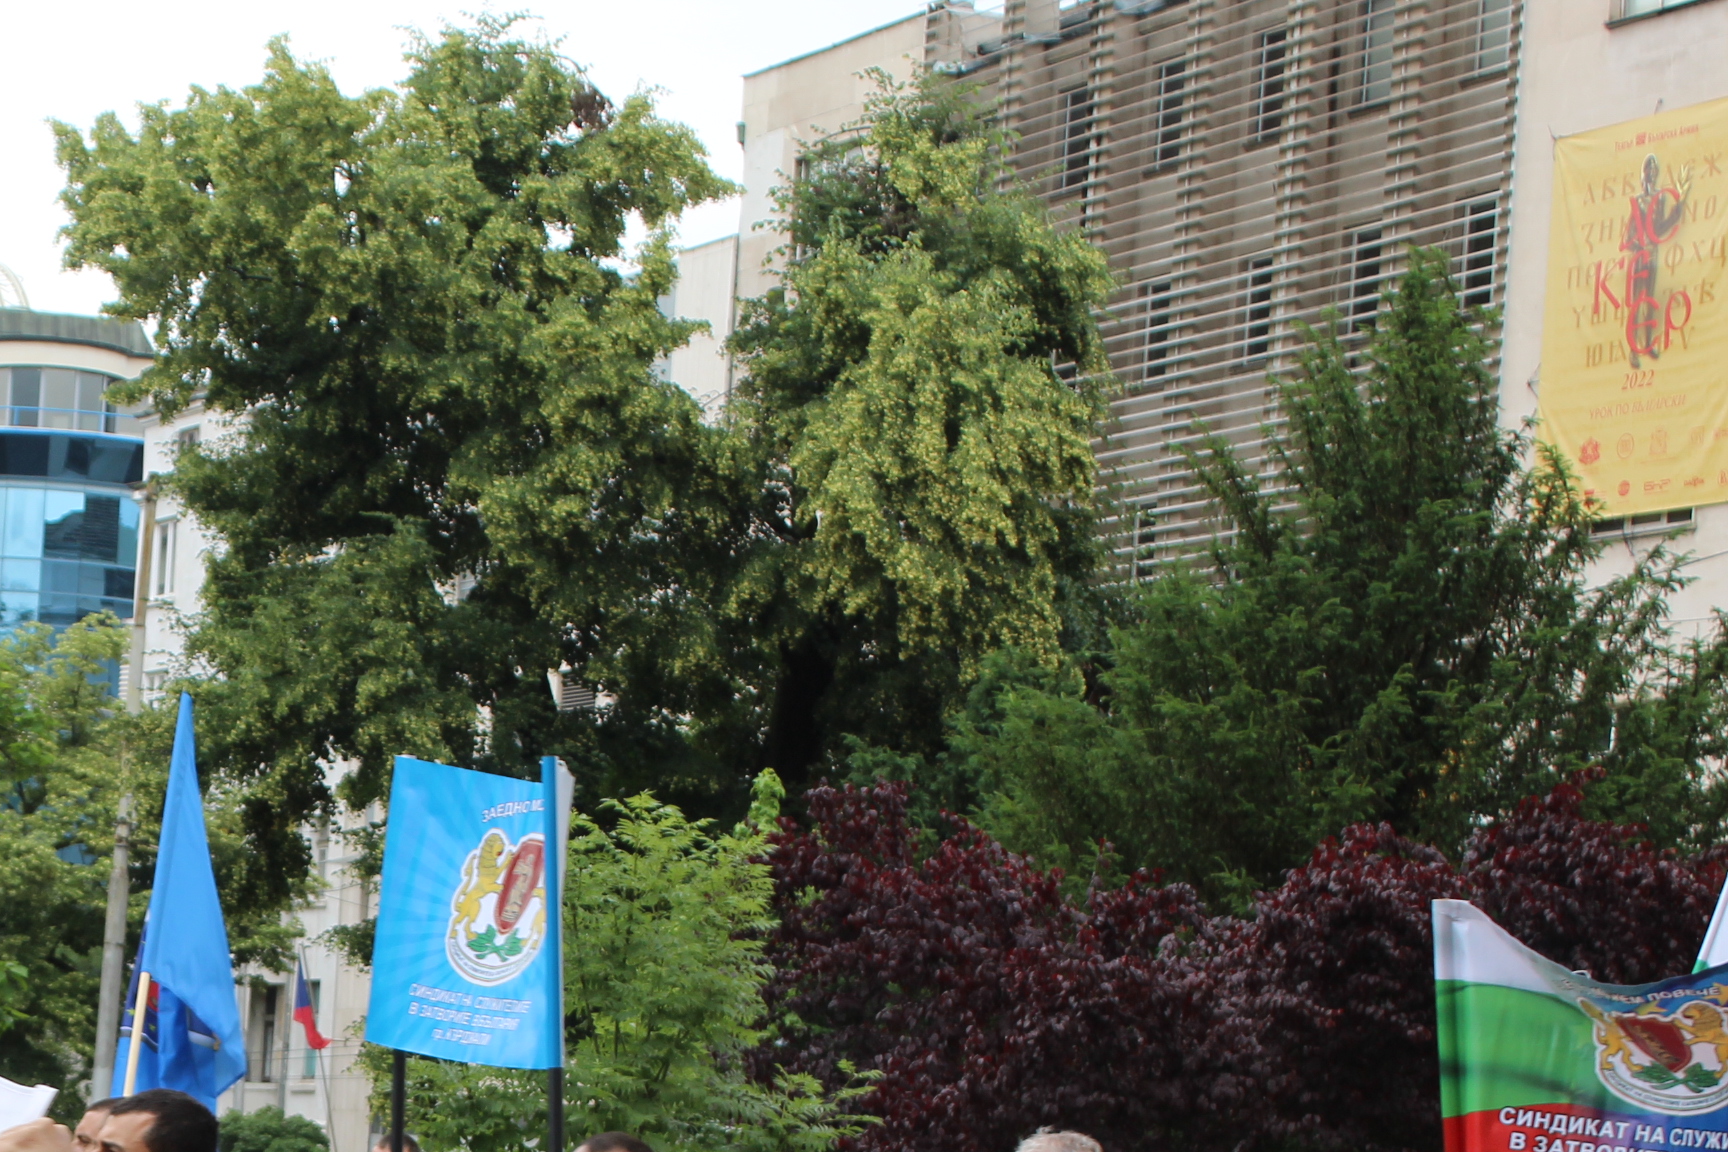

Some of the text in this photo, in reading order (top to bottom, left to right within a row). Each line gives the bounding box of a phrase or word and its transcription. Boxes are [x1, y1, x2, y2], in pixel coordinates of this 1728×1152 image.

[1621, 369, 1654, 390] 2022
[1615, 403, 1629, 416] ПО
[481, 800, 531, 823] ЗАЕДНО
[1499, 1107, 1630, 1139] СИНДИКАТ
[1634, 1124, 1665, 1144] НА
[1509, 1132, 1526, 1150] В
